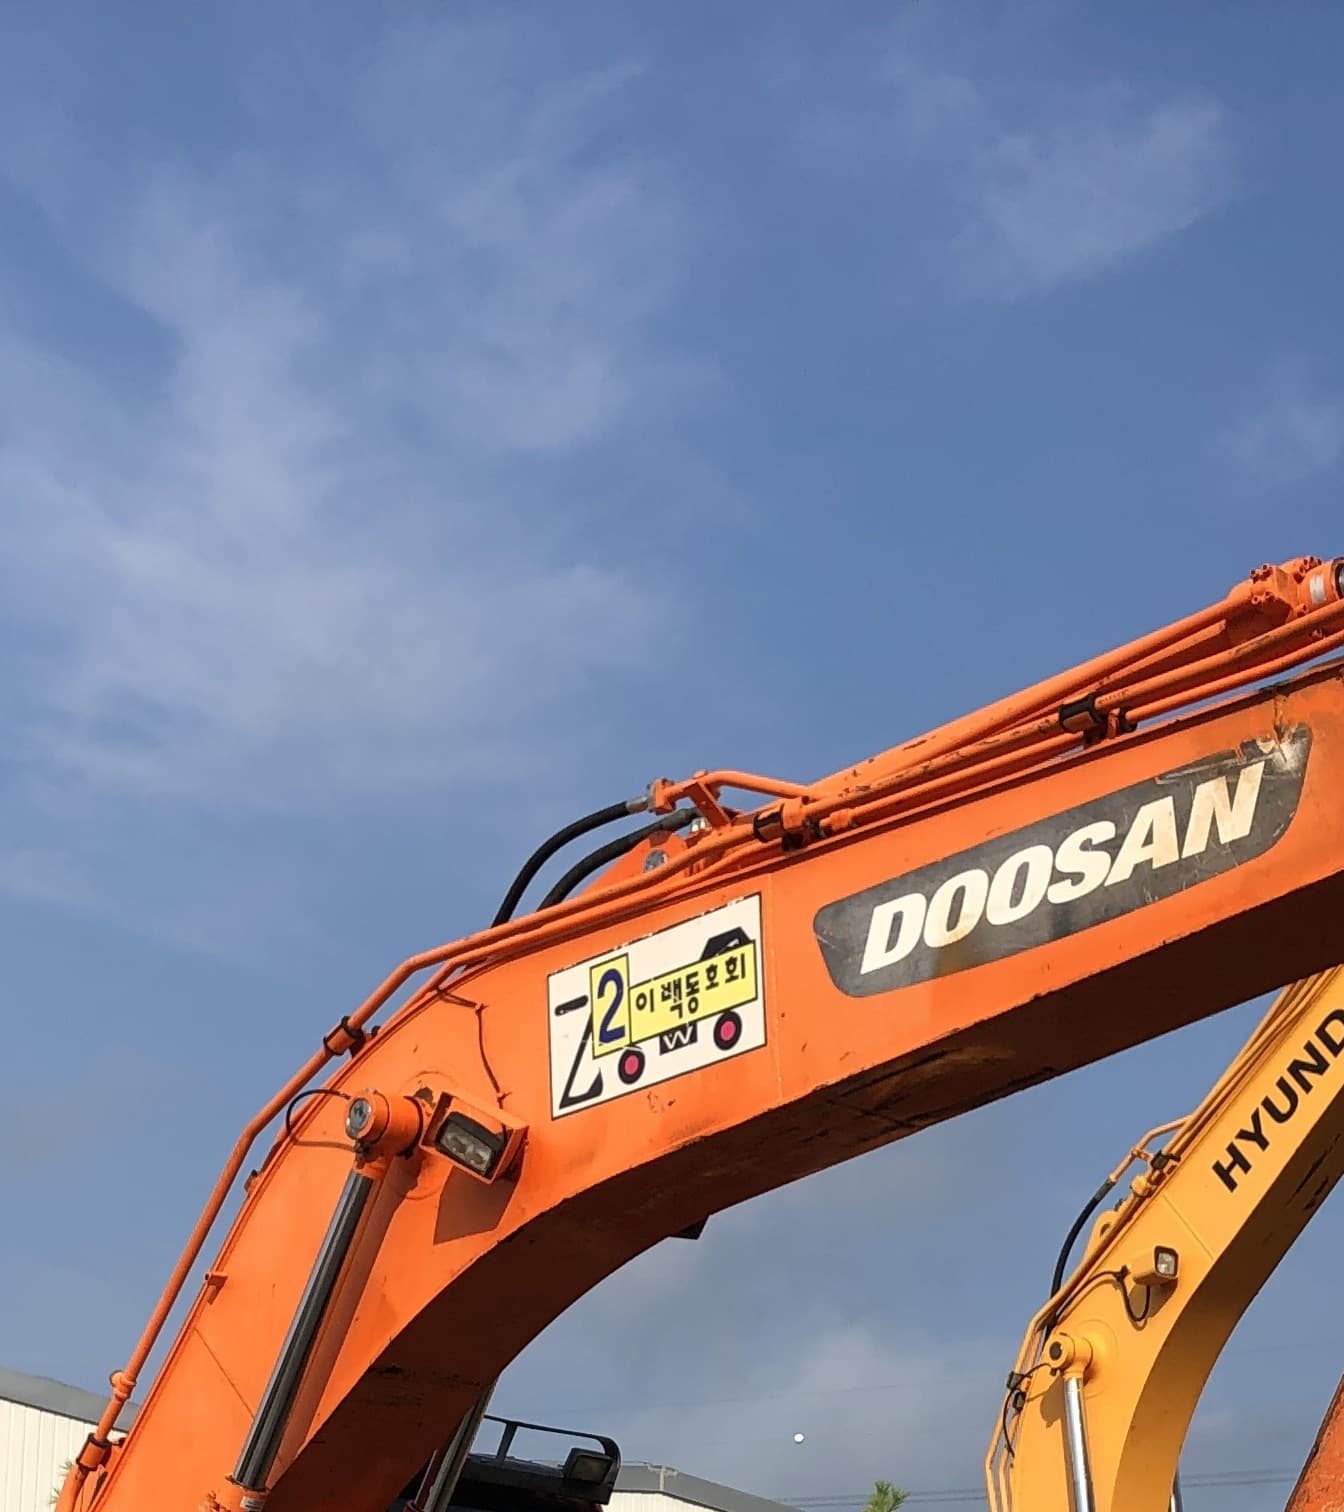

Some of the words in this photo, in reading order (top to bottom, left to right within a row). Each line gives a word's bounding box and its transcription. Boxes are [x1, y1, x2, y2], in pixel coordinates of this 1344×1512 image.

[860, 761, 1265, 976] DOOSAN
[597, 968, 626, 1043] 2
[635, 953, 746, 1019] 이백동호회
